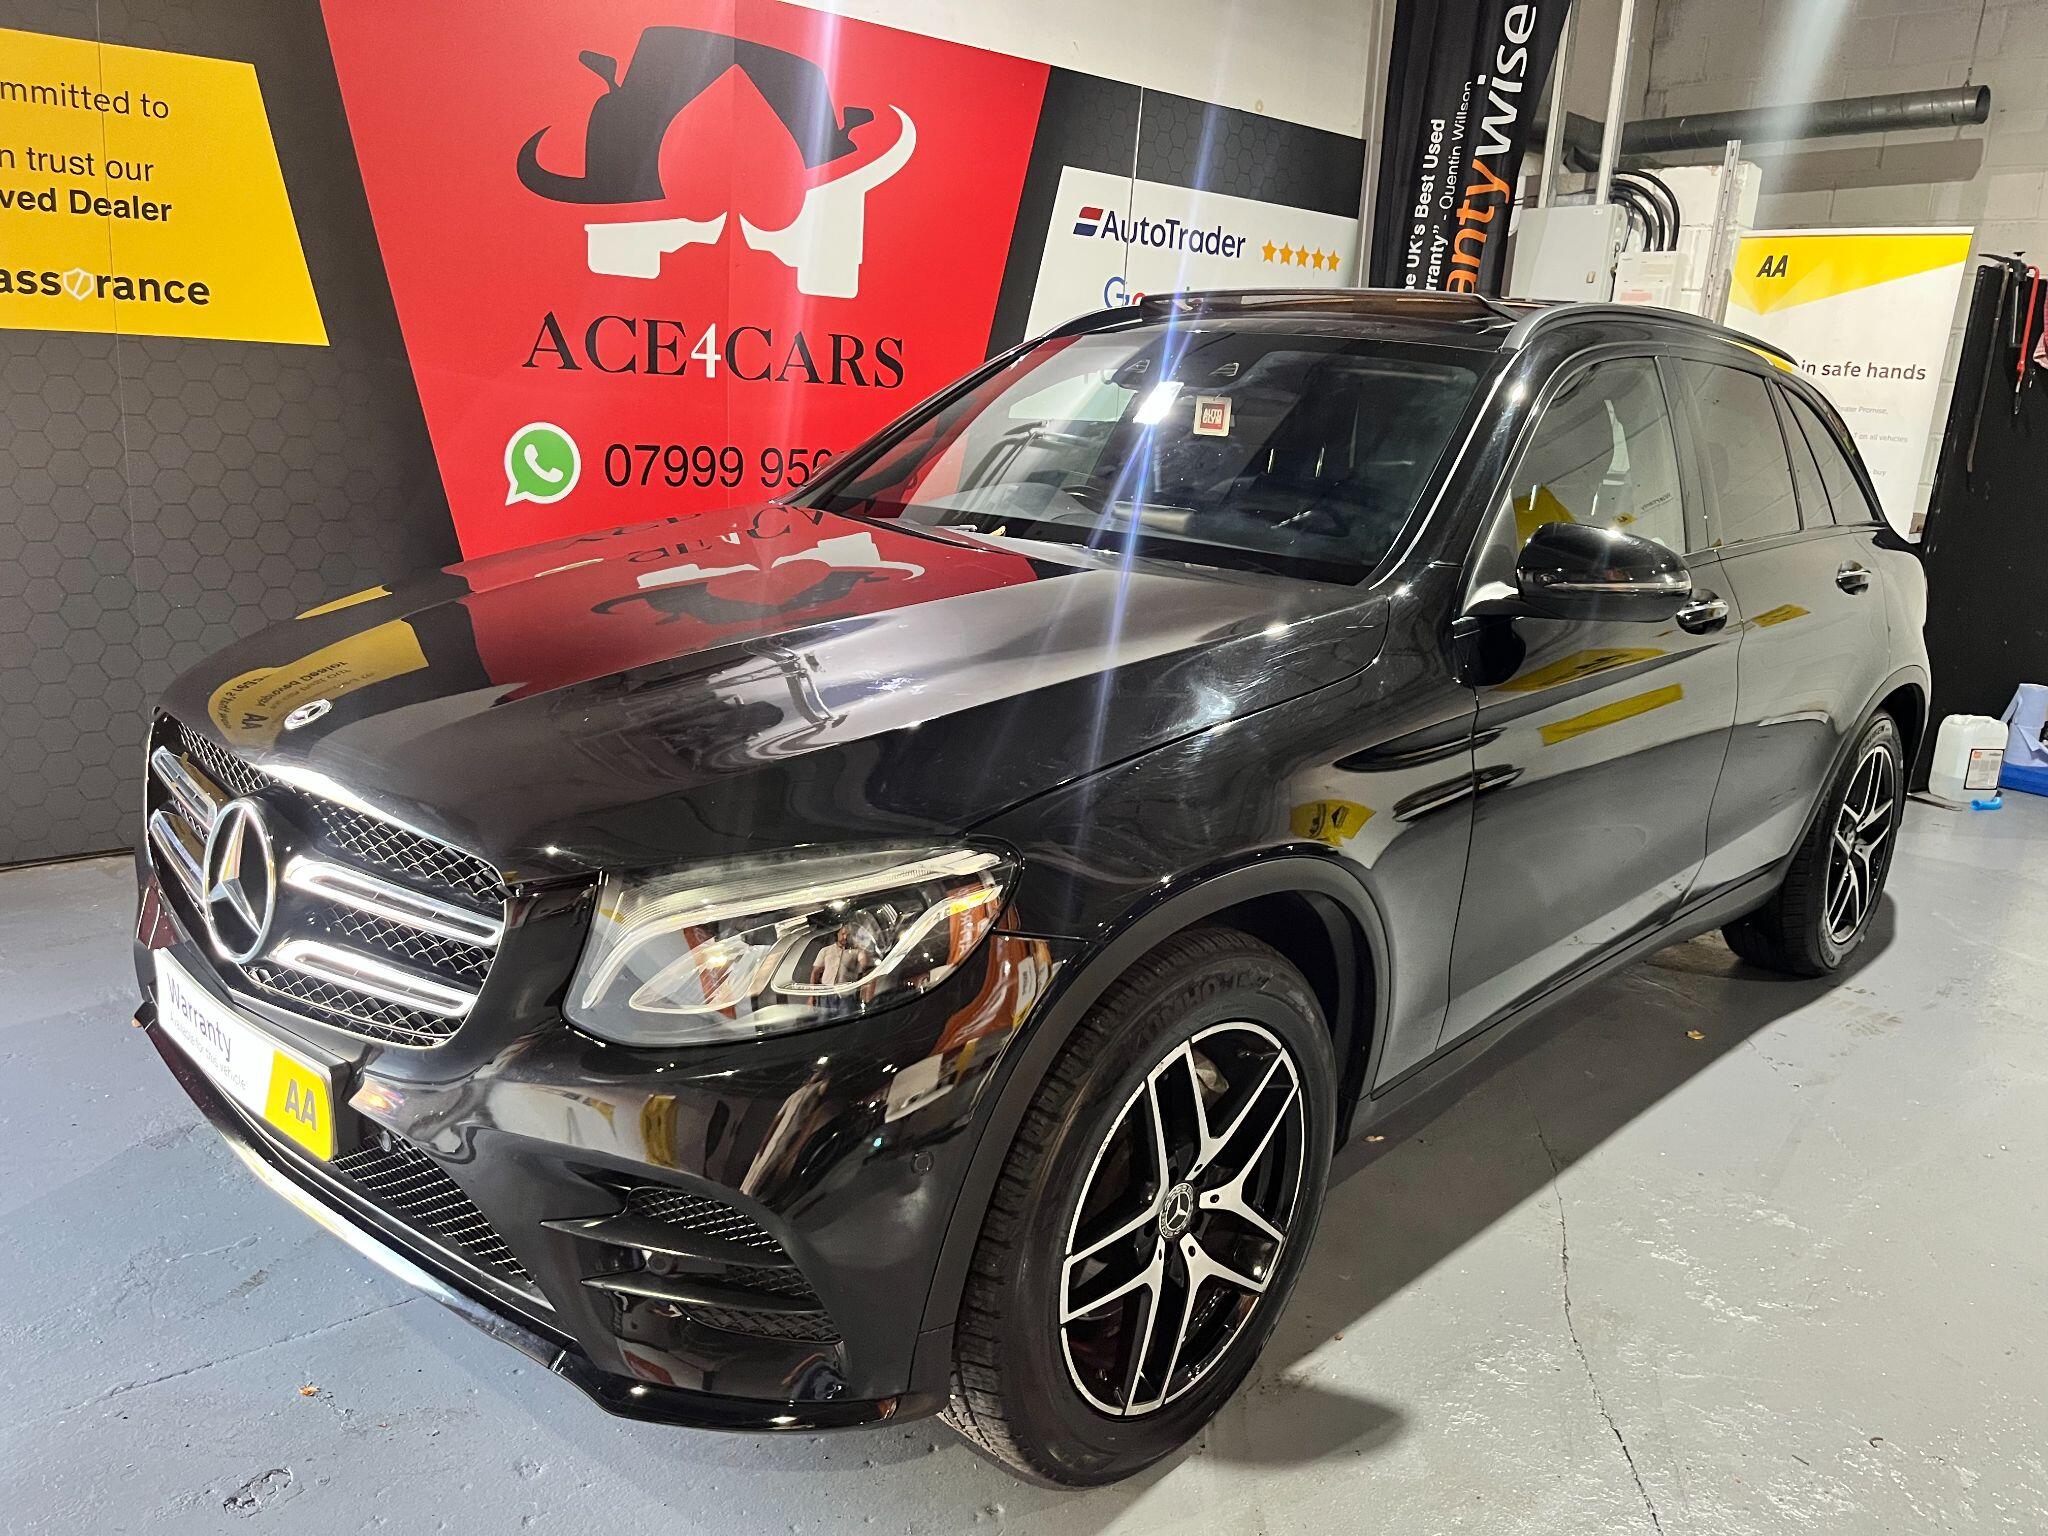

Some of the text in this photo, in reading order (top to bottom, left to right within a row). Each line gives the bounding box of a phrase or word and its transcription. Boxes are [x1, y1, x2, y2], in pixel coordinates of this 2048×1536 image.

[0, 81, 170, 119] mmitted to
[26, 147, 96, 178] trust
[105, 159, 155, 182] our
[1422, 119, 1446, 169] Used
[1439, 145, 1462, 210] Quentin
[1451, 81, 1472, 141] Willson
[69, 189, 173, 222] Dealer
[1414, 174, 1436, 218] Best
[1101, 210, 1247, 259] AutoTrader
[1406, 224, 1426, 268] UK's
[1755, 255, 1789, 278] AA
[521, 311, 906, 389] ACE4CARS
[1801, 360, 1927, 381] in safe hands
[1204, 408, 1223, 418] AUTO
[604, 444, 745, 488] 07999
[166, 972, 232, 1062] Warranty
[284, 1078, 318, 1132] AA
